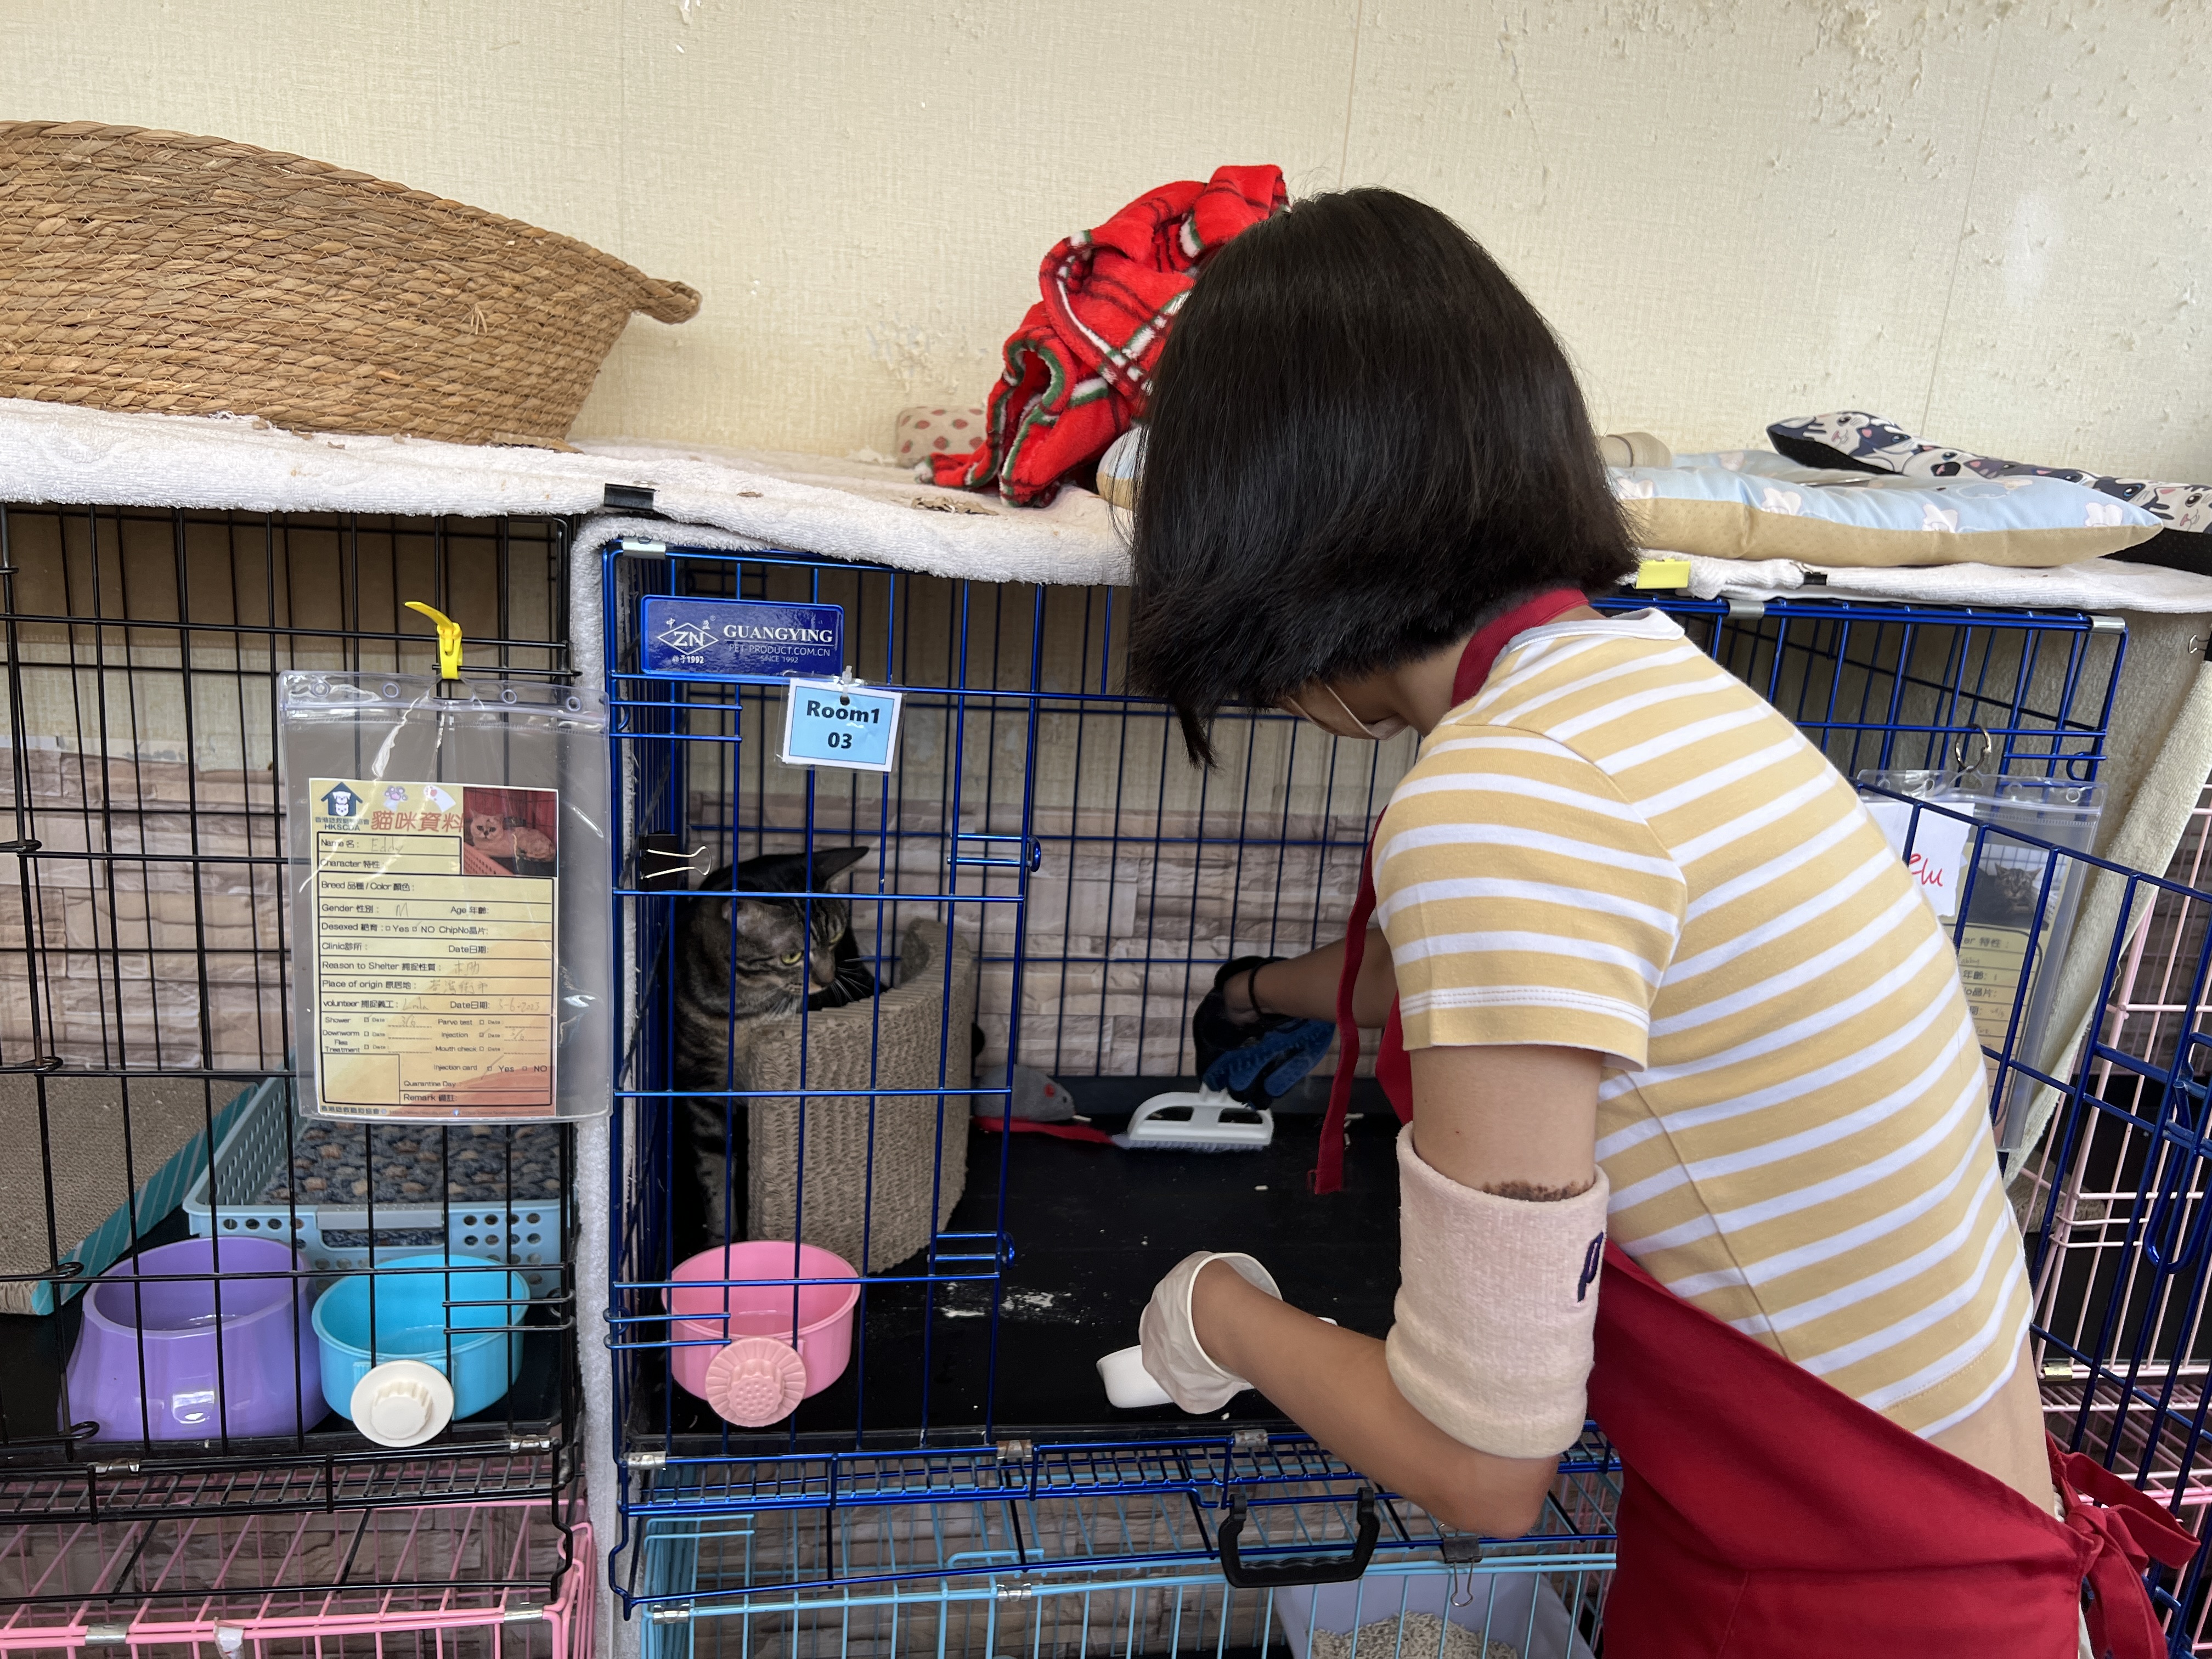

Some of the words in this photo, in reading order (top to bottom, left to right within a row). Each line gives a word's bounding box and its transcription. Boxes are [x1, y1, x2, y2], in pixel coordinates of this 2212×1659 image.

[723, 624, 833, 642] GUANGYING
[673, 631, 704, 647] ZN
[729, 644, 831, 657] PET-PRODUCT.COM.CN
[806, 699, 880, 724] Room1
[827, 732, 853, 749] 03
[371, 810, 464, 833] 貓咪資料
[371, 837, 404, 853] Eddy
[370, 882, 391, 890] Color
[321, 904, 353, 912] Gender
[450, 906, 466, 915] Age
[321, 922, 358, 930] Desexed
[322, 961, 354, 969] Reason
[369, 962, 399, 970] Shelter
[360, 980, 383, 989] origin
[323, 999, 359, 1007] volunteer
[403, 1093, 436, 1102] Remark
